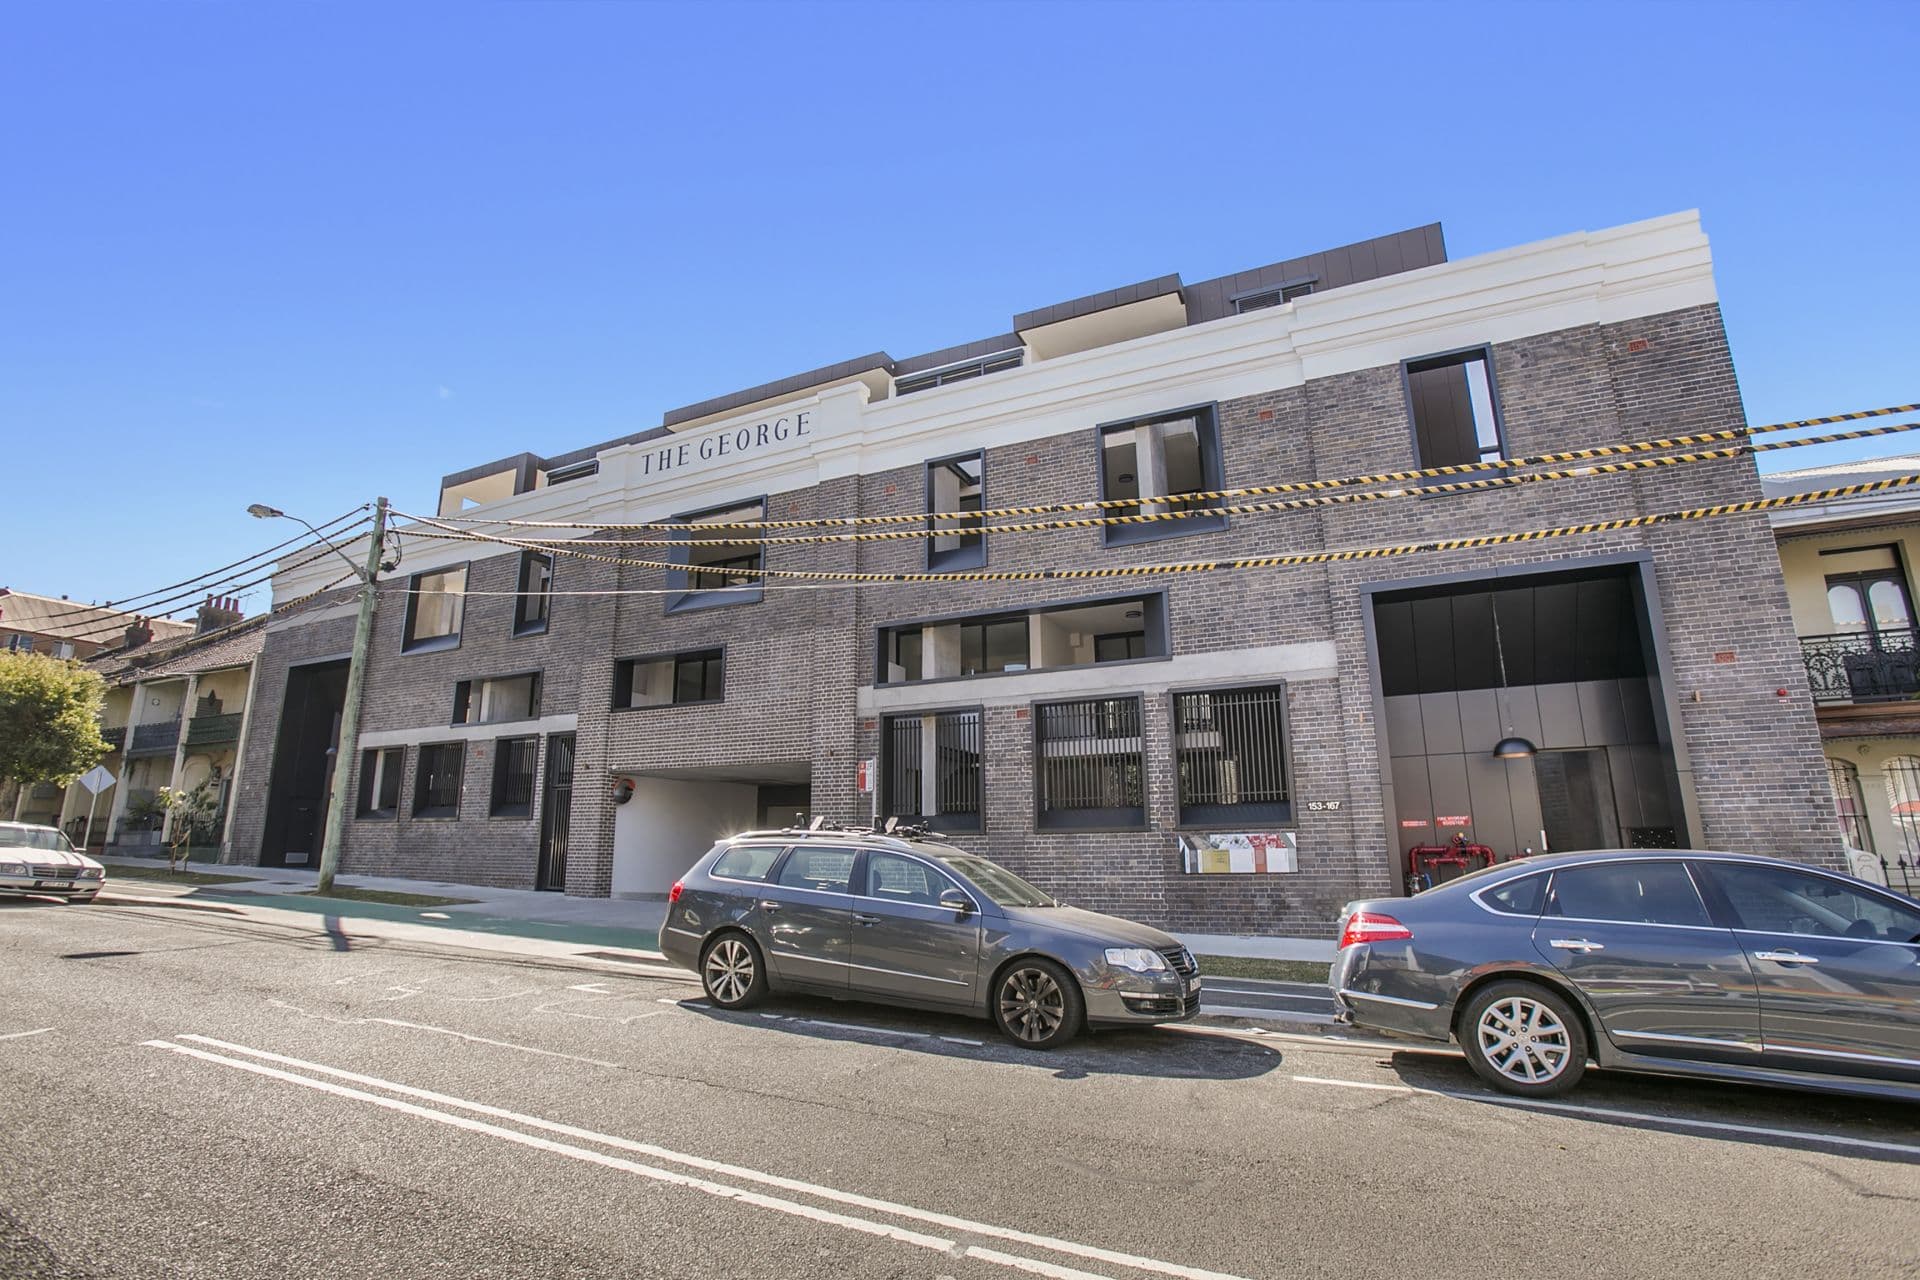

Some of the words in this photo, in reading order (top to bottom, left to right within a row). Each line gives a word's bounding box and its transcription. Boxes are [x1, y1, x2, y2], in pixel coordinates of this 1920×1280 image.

[642, 443, 691, 474] THE
[700, 412, 811, 460] GEORGE
[1308, 802, 1340, 811] 153-167
